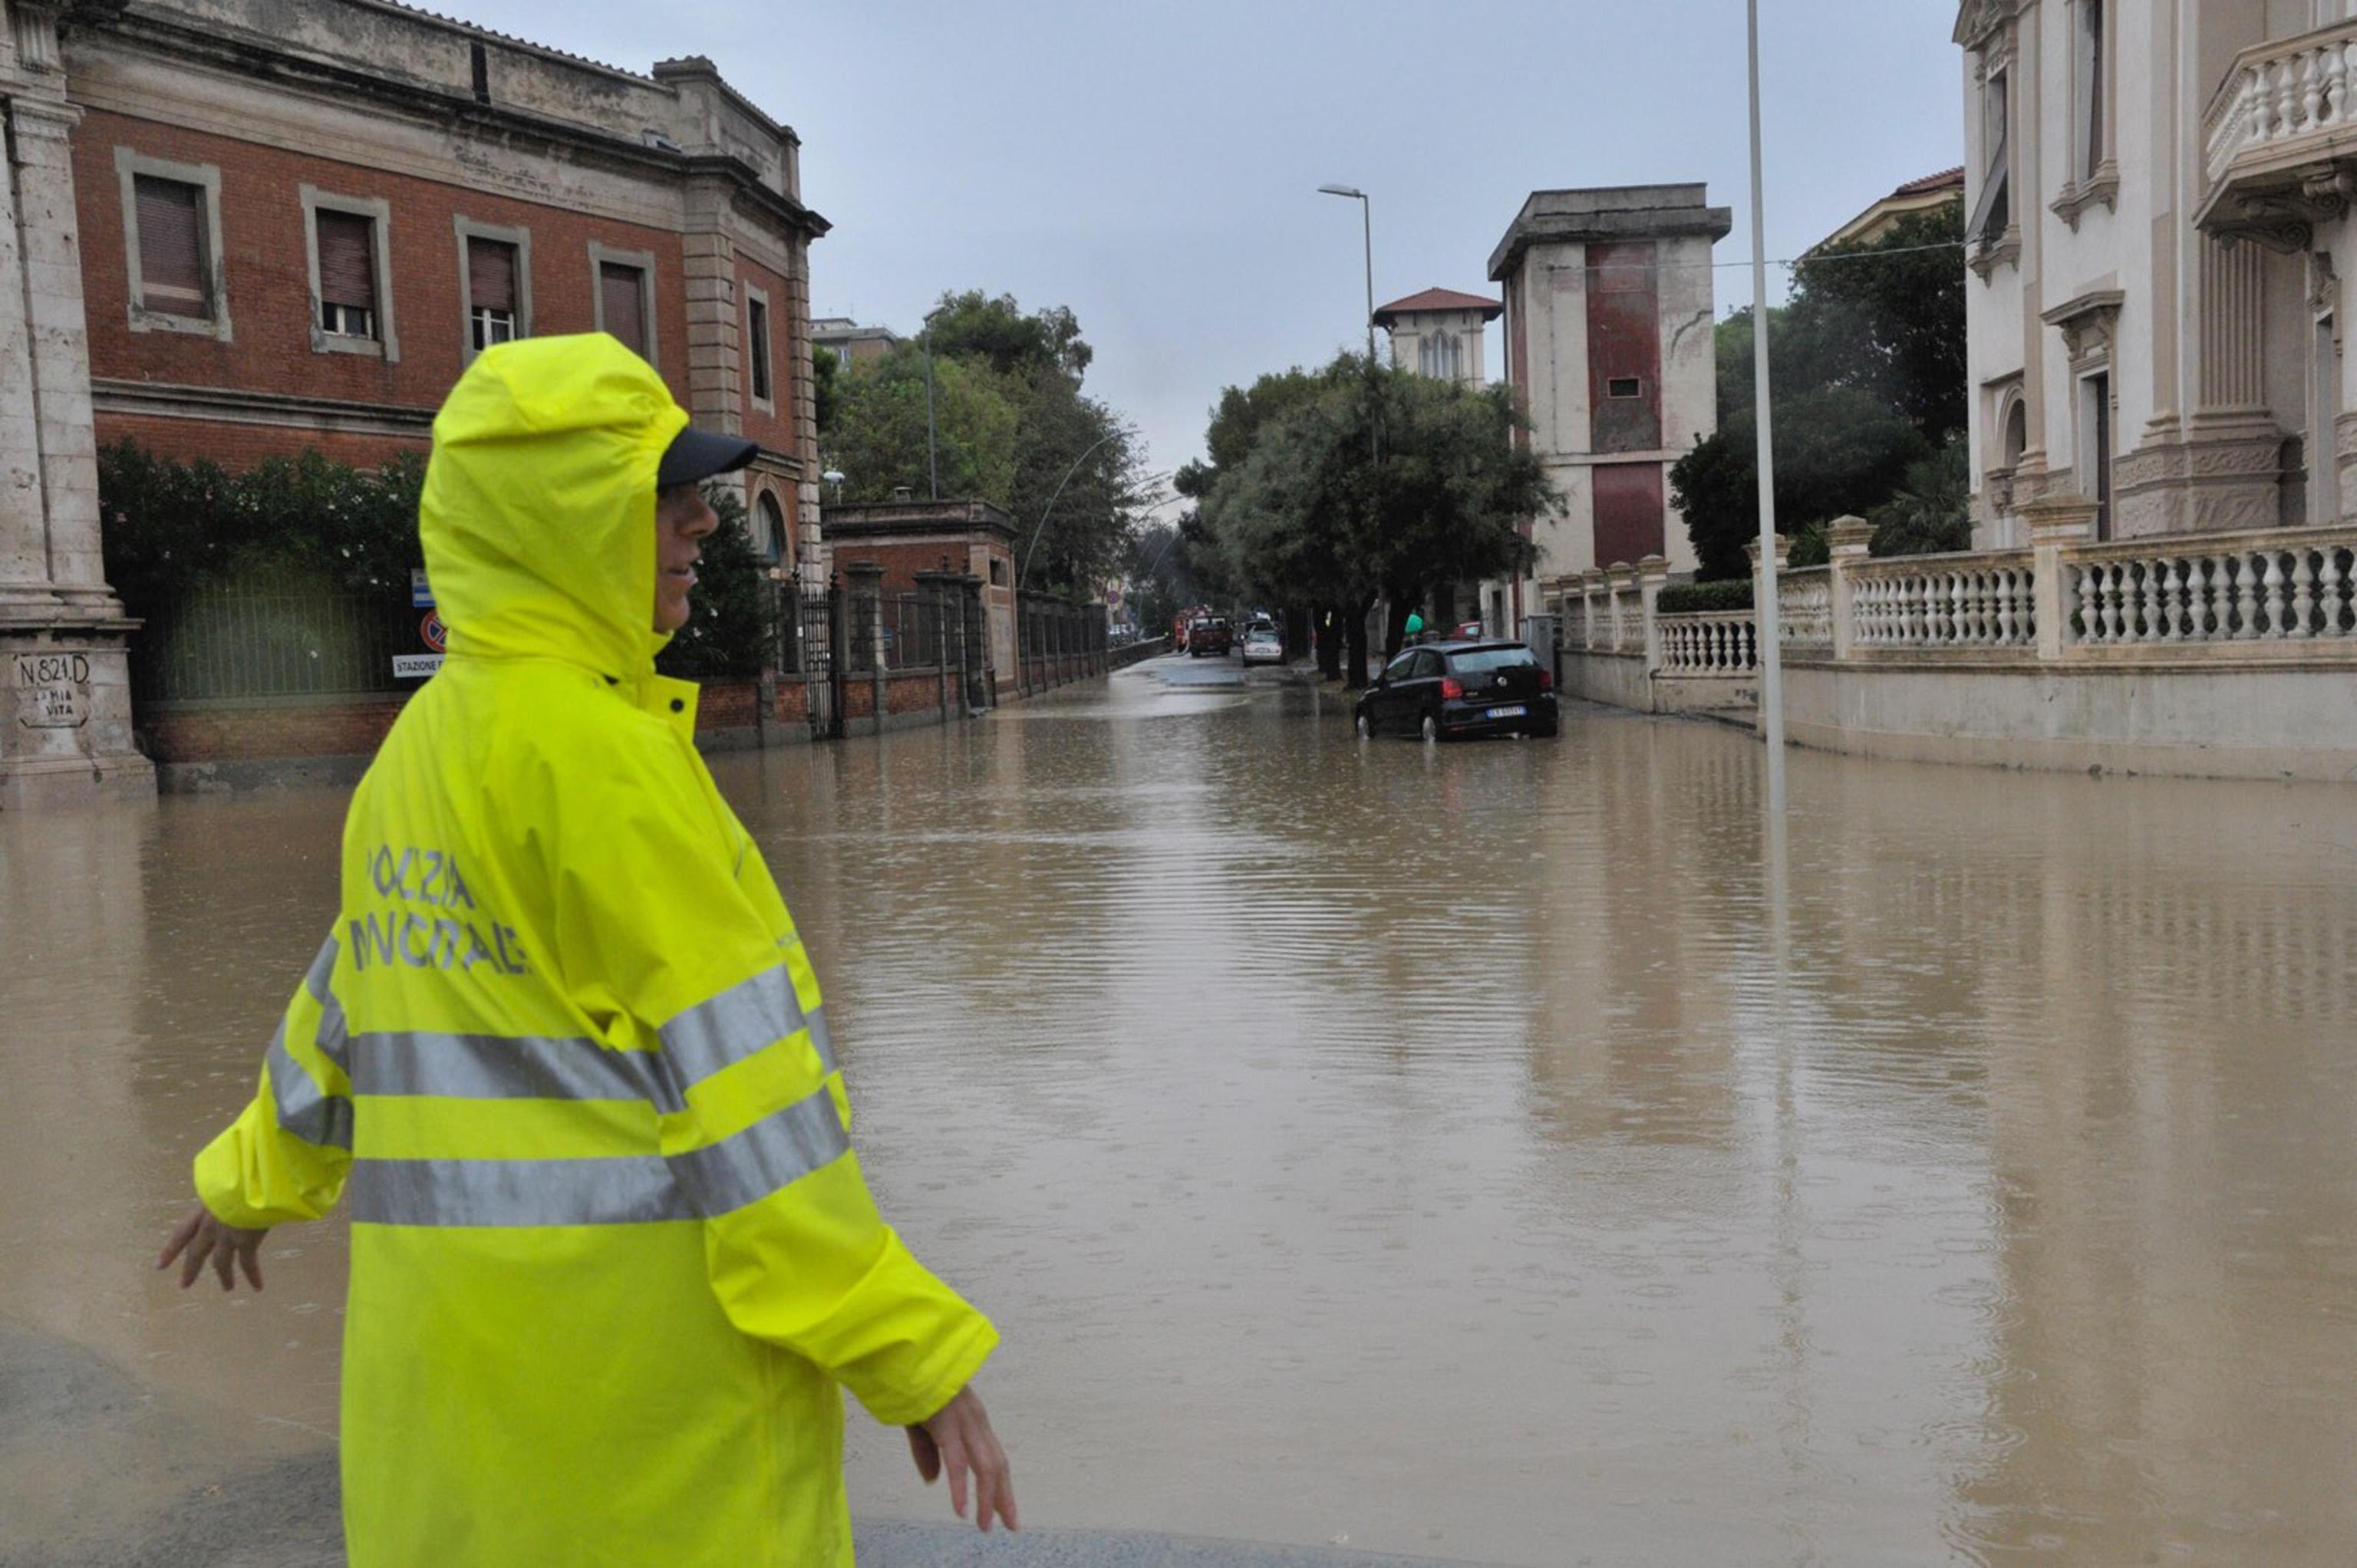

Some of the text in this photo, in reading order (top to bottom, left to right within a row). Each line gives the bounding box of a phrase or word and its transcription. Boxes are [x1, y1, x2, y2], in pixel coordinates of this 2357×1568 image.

[397, 660, 437, 672] STAZIONE
[50, 690, 72, 701] MIA
[46, 704, 73, 716] VITA
